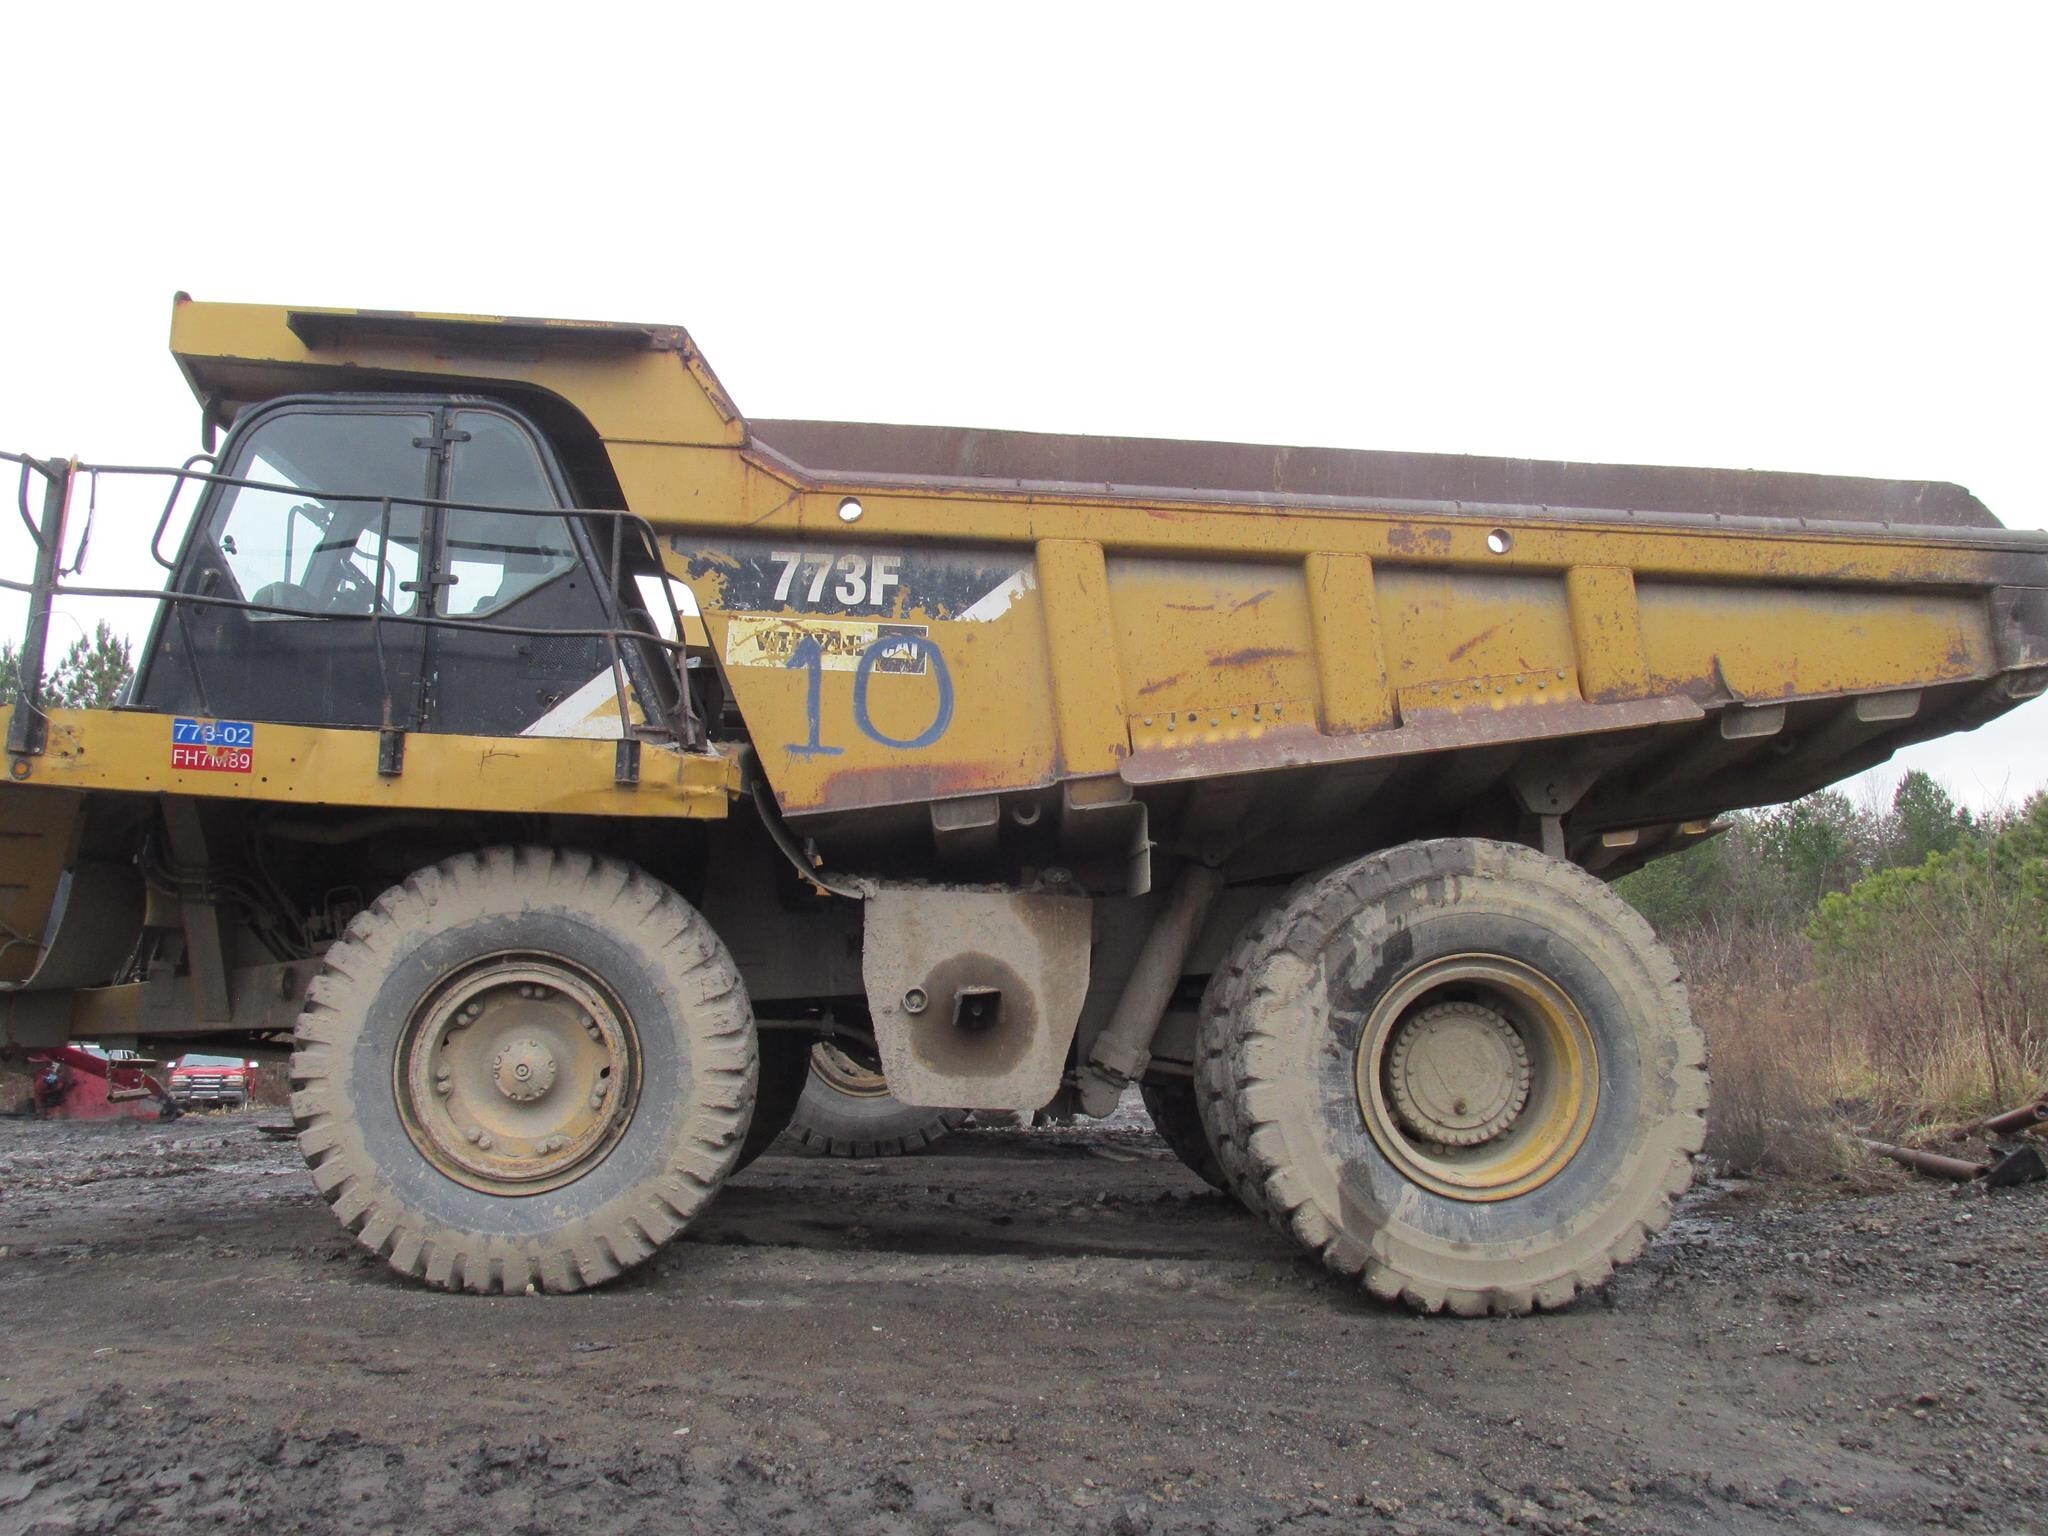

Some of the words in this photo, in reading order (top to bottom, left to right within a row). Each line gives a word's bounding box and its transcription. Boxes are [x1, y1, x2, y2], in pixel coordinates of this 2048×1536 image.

[770, 551, 901, 606] 773F
[783, 634, 954, 756] 10
[174, 723, 251, 744] 773-02
